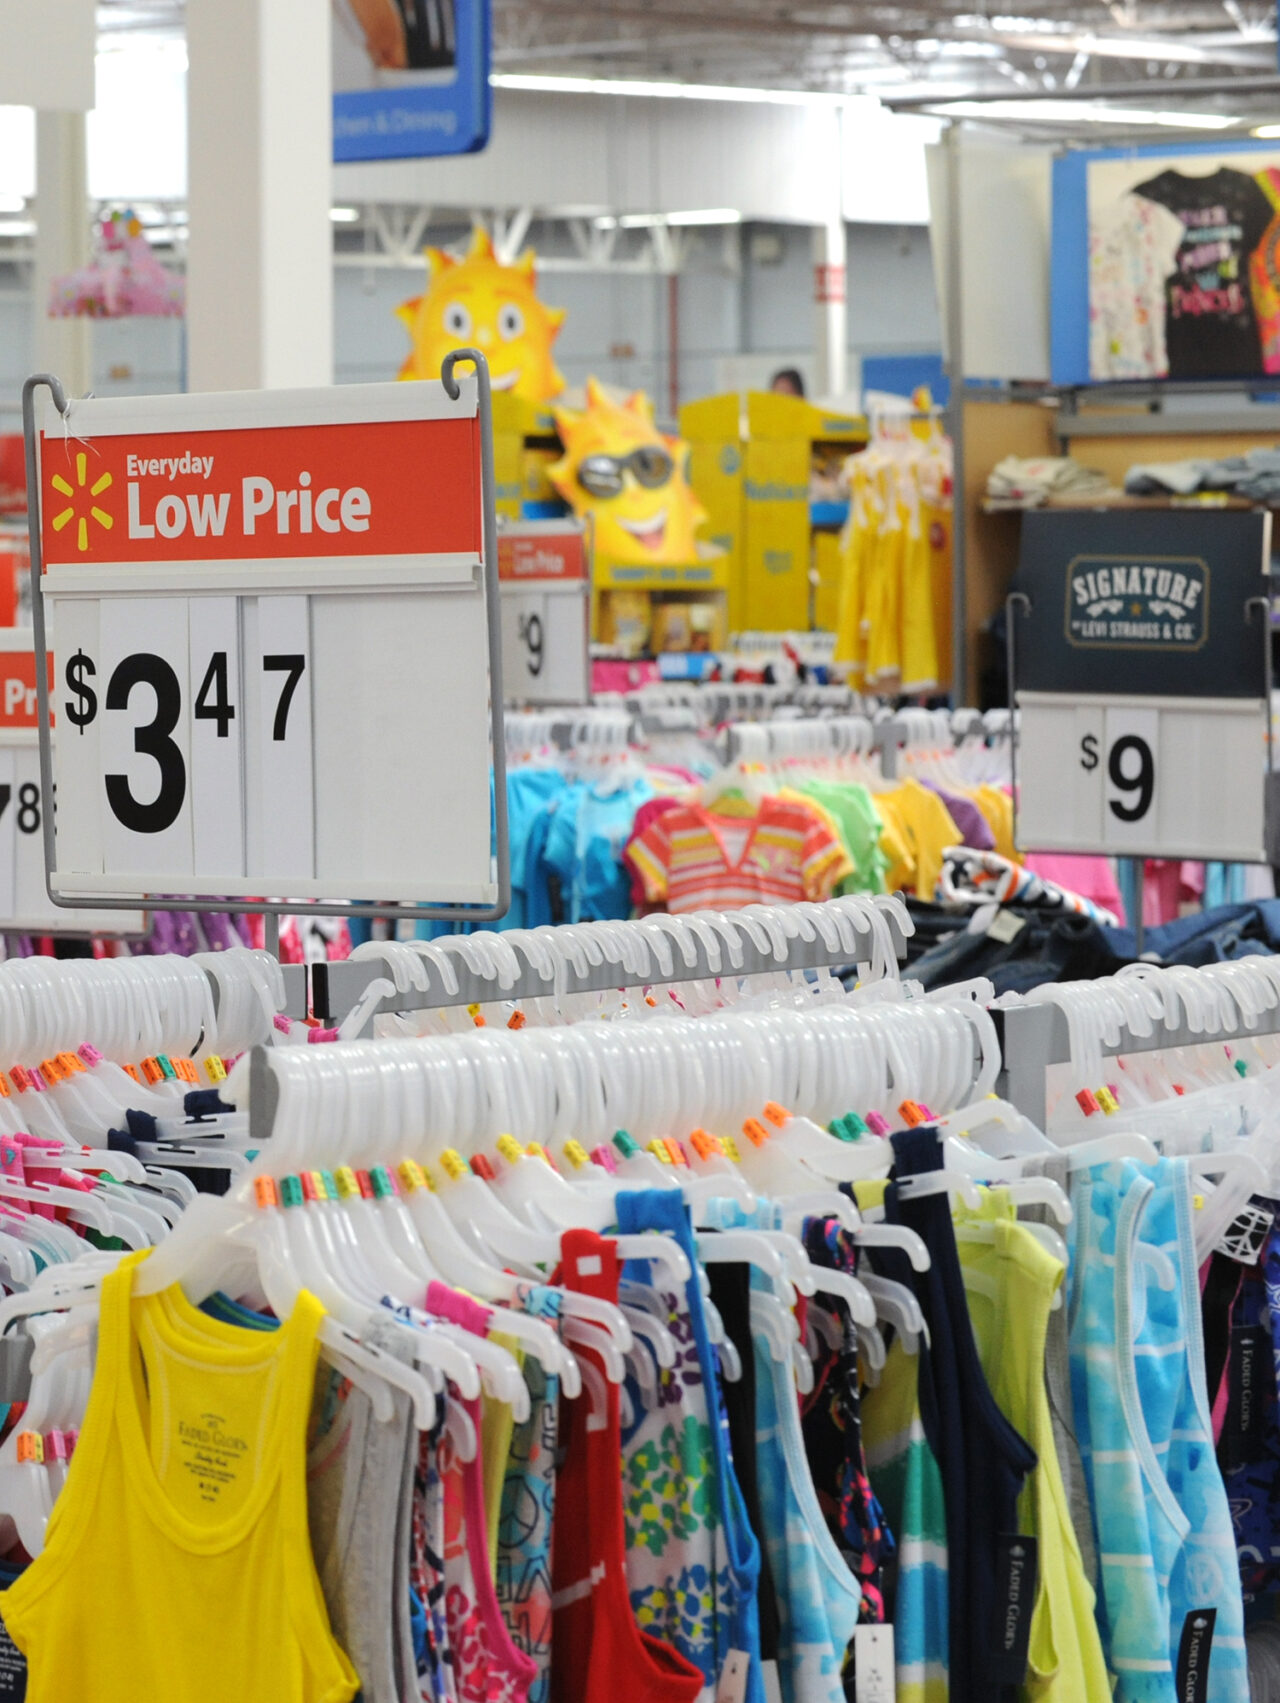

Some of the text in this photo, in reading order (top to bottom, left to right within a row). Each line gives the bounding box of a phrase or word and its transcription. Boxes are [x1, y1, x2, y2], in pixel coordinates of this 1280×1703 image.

[127, 452, 215, 481] Everyday
[127, 471, 372, 539] Low Price
[1073, 566, 1203, 610] SIGNATURE
[1082, 620, 1108, 638] LEVI
[1110, 621, 1161, 639] STRAUSS
[1241, 1349, 1254, 1387] FADED
[1008, 1561, 1024, 1600] FADED
[1188, 1631, 1204, 1668] FADED
